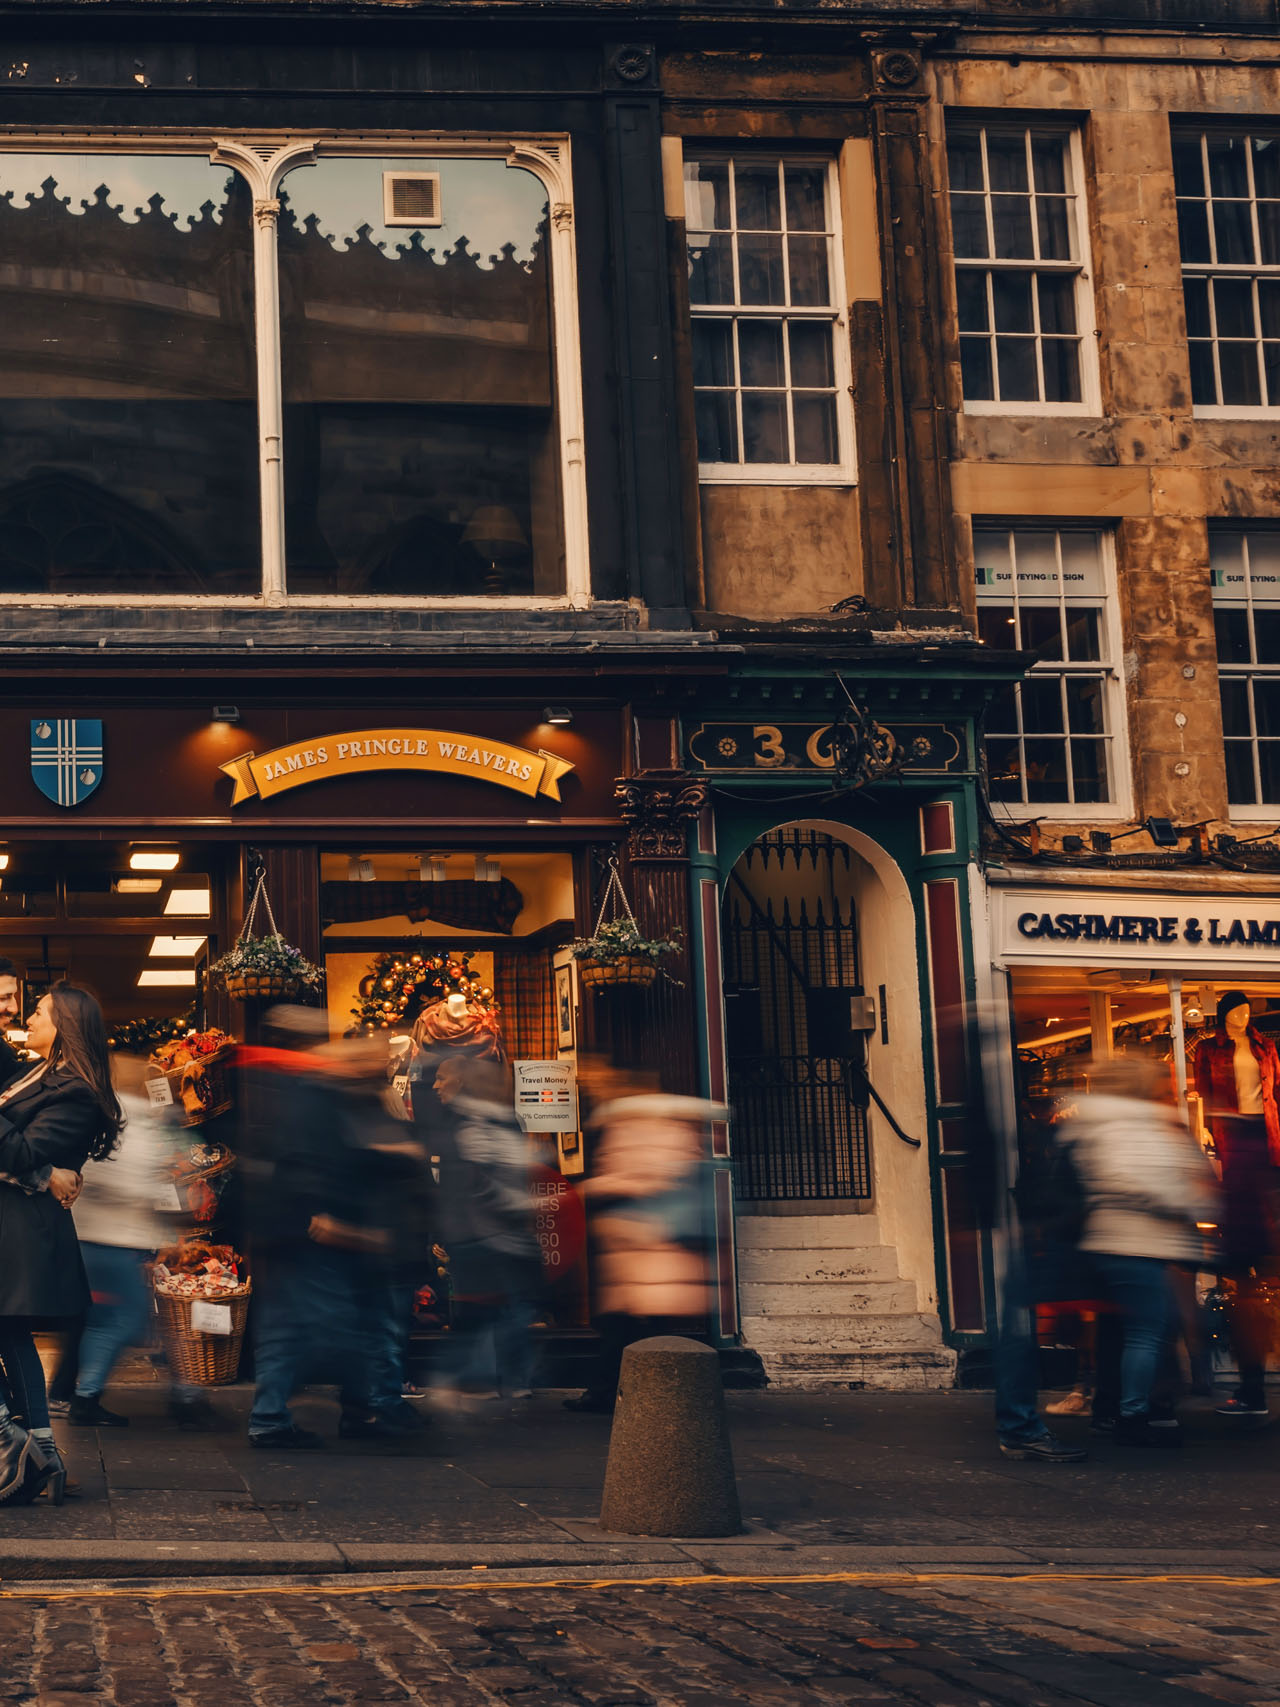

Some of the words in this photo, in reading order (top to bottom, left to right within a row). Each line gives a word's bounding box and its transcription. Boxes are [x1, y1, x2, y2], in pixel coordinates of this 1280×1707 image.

[1052, 573, 1084, 581] DSIGN
[263, 746, 329, 781] JAMES
[336, 738, 430, 760] PRINGLE
[436, 740, 533, 781] WEAVERS
[1017, 912, 1179, 942] CASHMERE
[1183, 917, 1203, 943] &
[1208, 918, 1280, 945] LAM
[545, 1077, 568, 1085] Money
